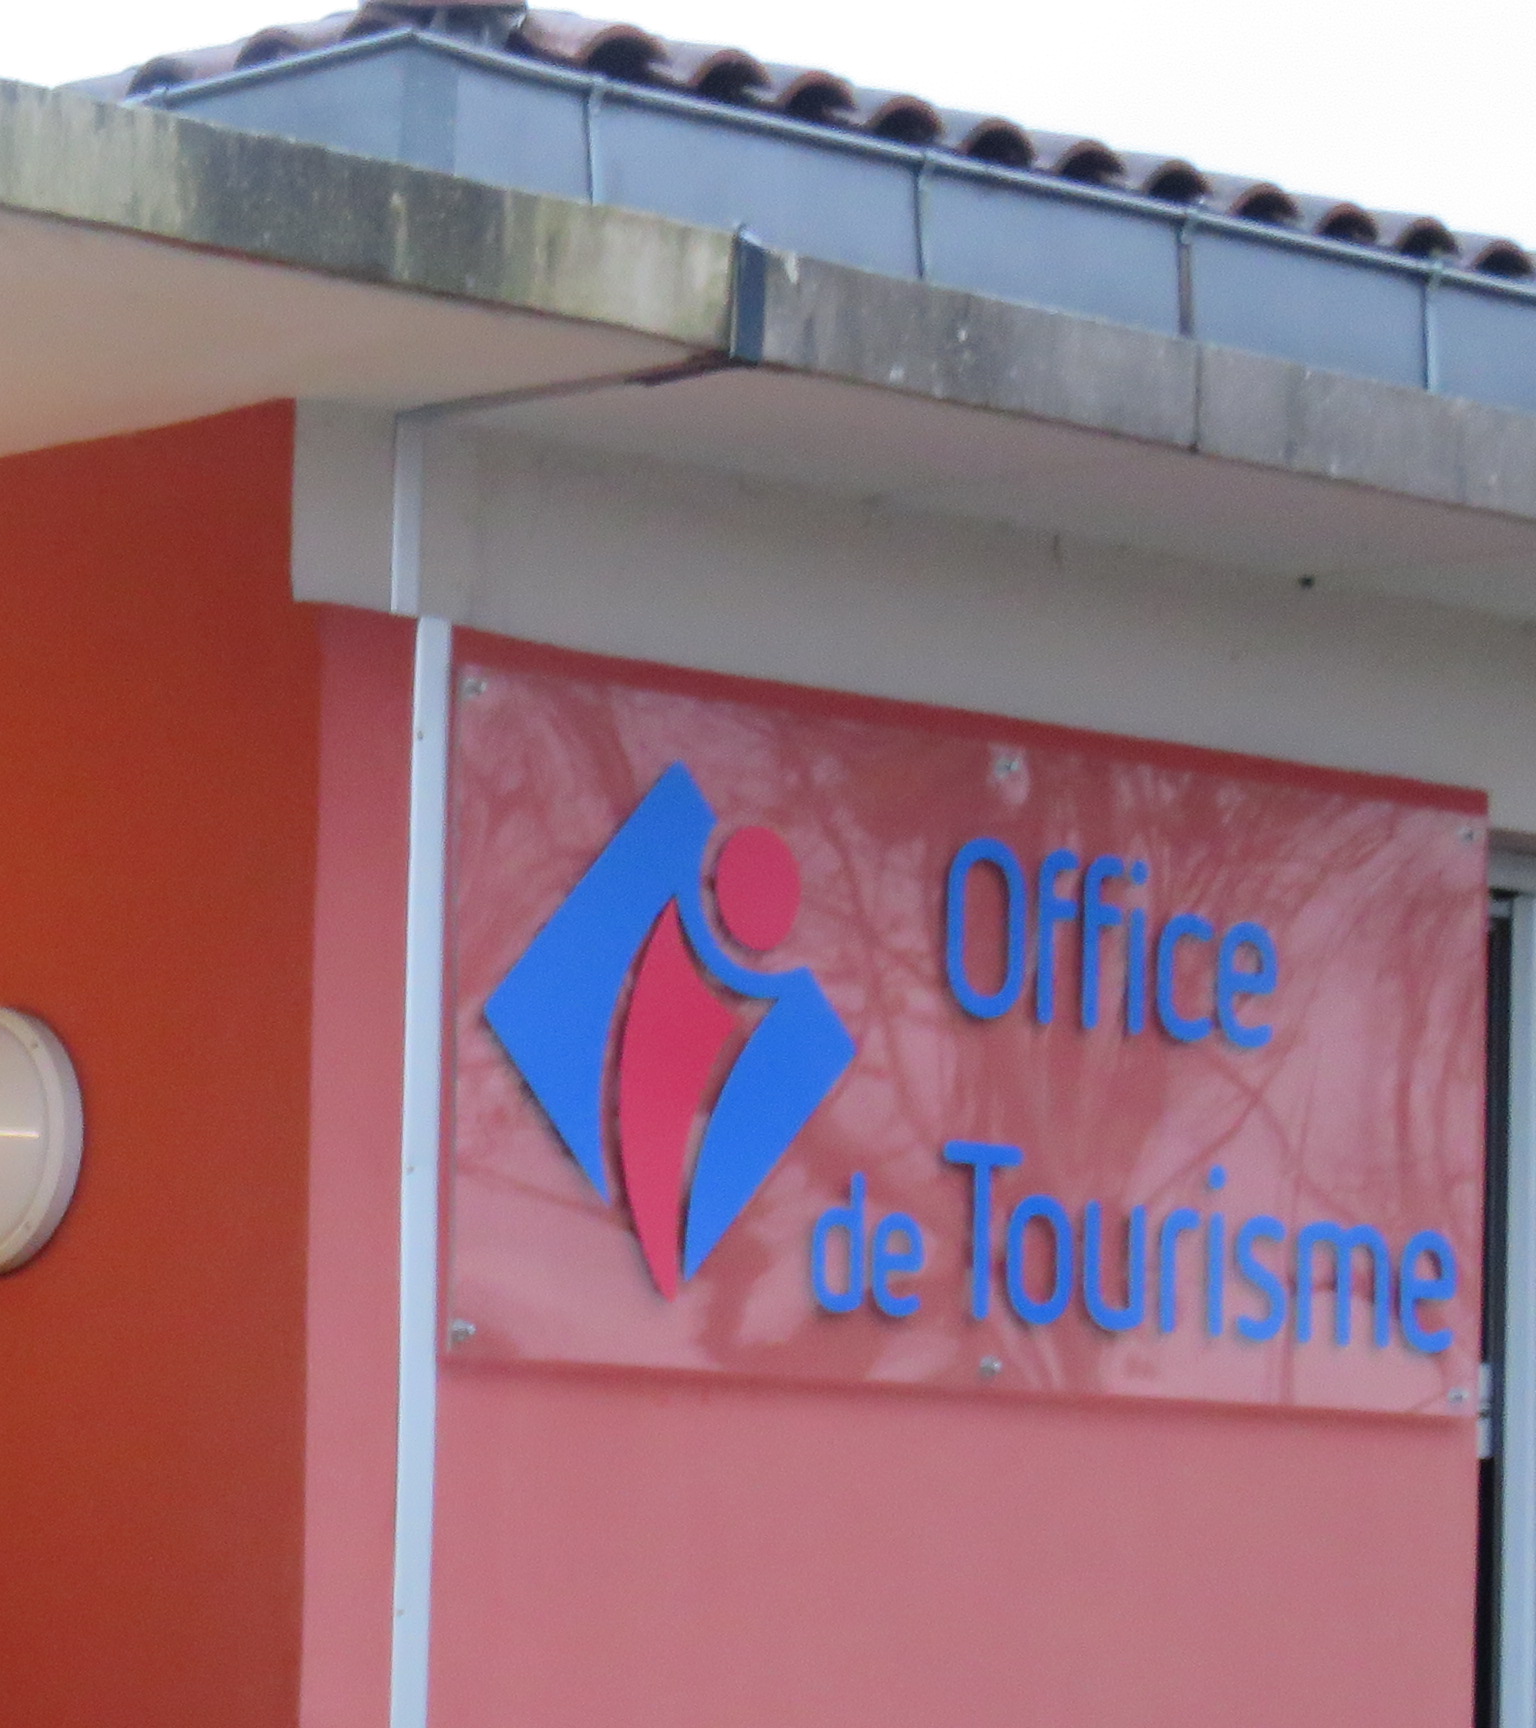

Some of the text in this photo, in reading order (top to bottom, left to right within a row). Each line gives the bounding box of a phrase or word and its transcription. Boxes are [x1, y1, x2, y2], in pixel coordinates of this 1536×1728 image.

[945, 837, 1278, 1049] Office
[811, 1140, 1459, 1354] de Tourisme
